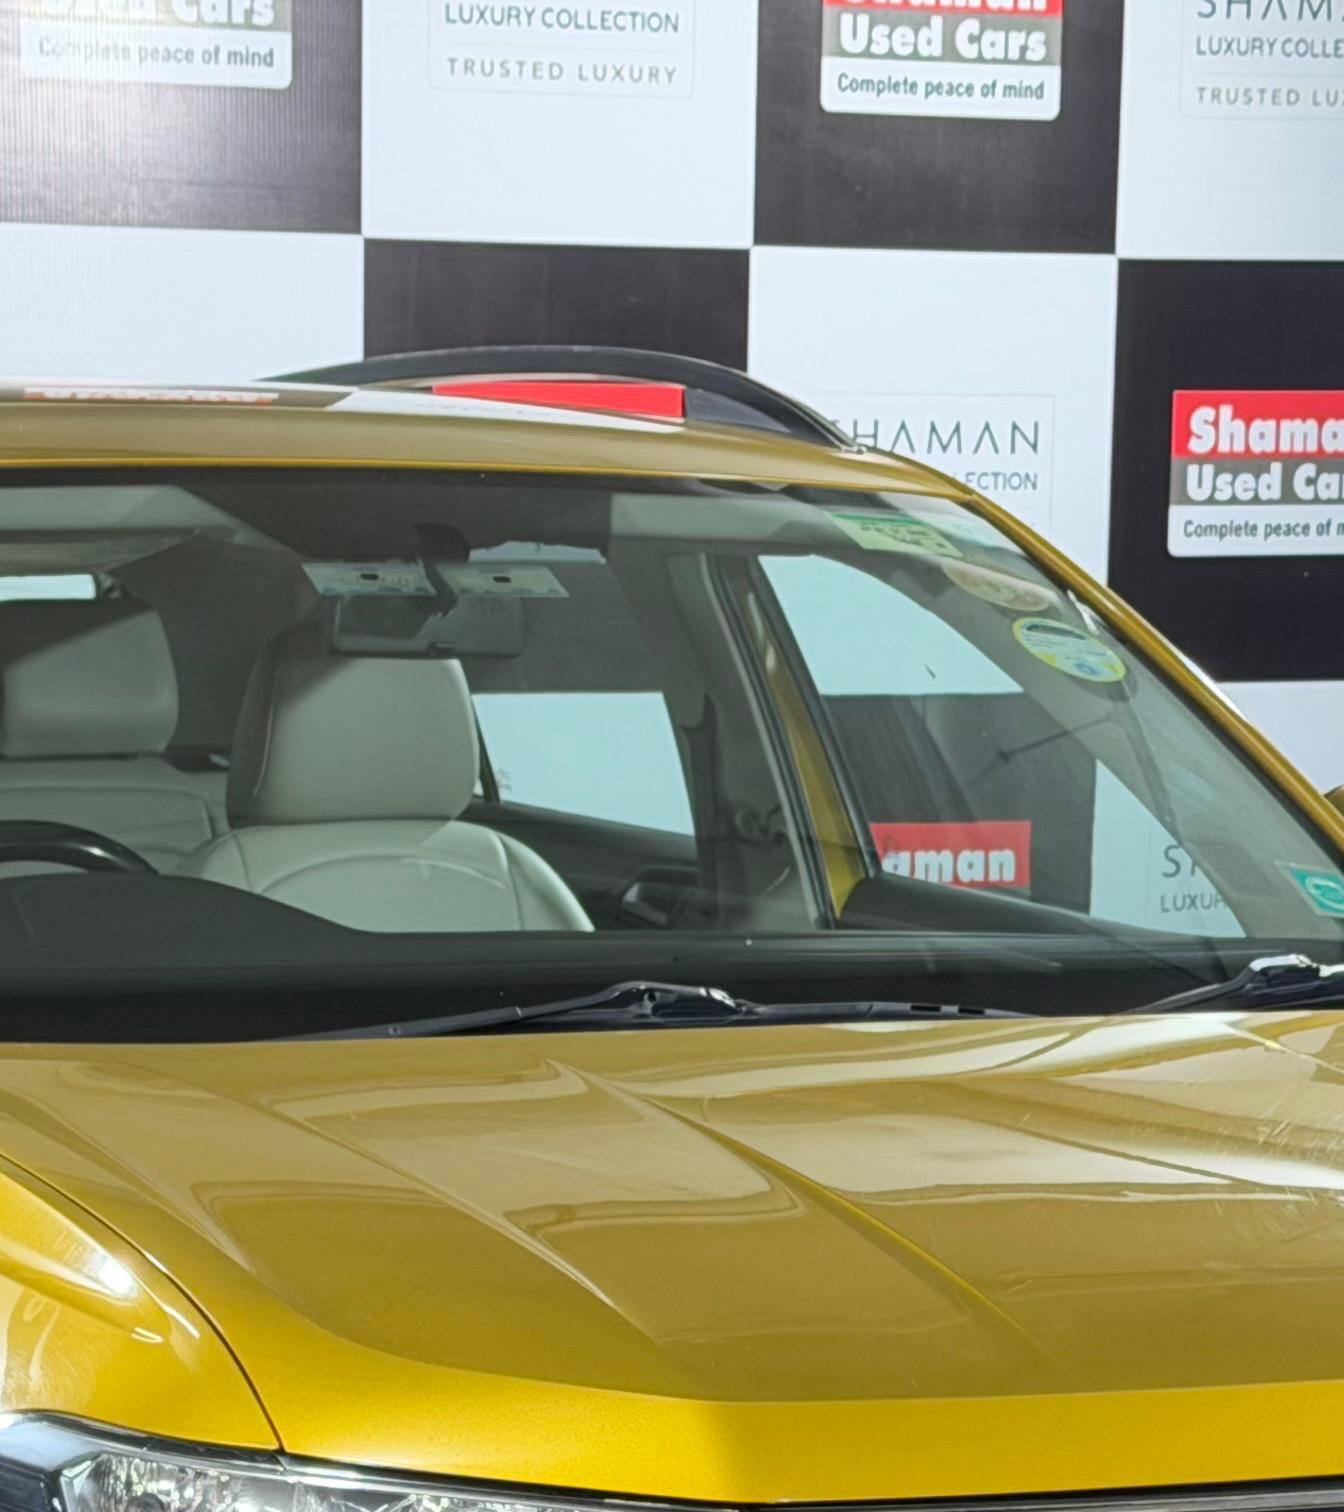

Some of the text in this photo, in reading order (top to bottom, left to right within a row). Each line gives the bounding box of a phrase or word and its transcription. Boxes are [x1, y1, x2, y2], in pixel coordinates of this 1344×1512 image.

[444, 2, 680, 33] LUXURY COLLECTION
[840, 13, 1047, 61] Used Cars
[1196, 36, 1277, 57] LUXURY
[138, 44, 195, 68] peace
[201, 45, 220, 66] of
[227, 46, 274, 68] mind
[447, 57, 677, 85] TRUSTED LUXURY
[838, 72, 1044, 100] Complete peace of mind
[1197, 86, 1300, 107] TRUSTED
[848, 419, 1039, 454] HAMAN
[965, 471, 1038, 490] ECTION
[1187, 462, 1282, 501] Used
[1184, 520, 1257, 541] Complete
[1264, 523, 1310, 541] peace
[1316, 519, 1332, 538] of
